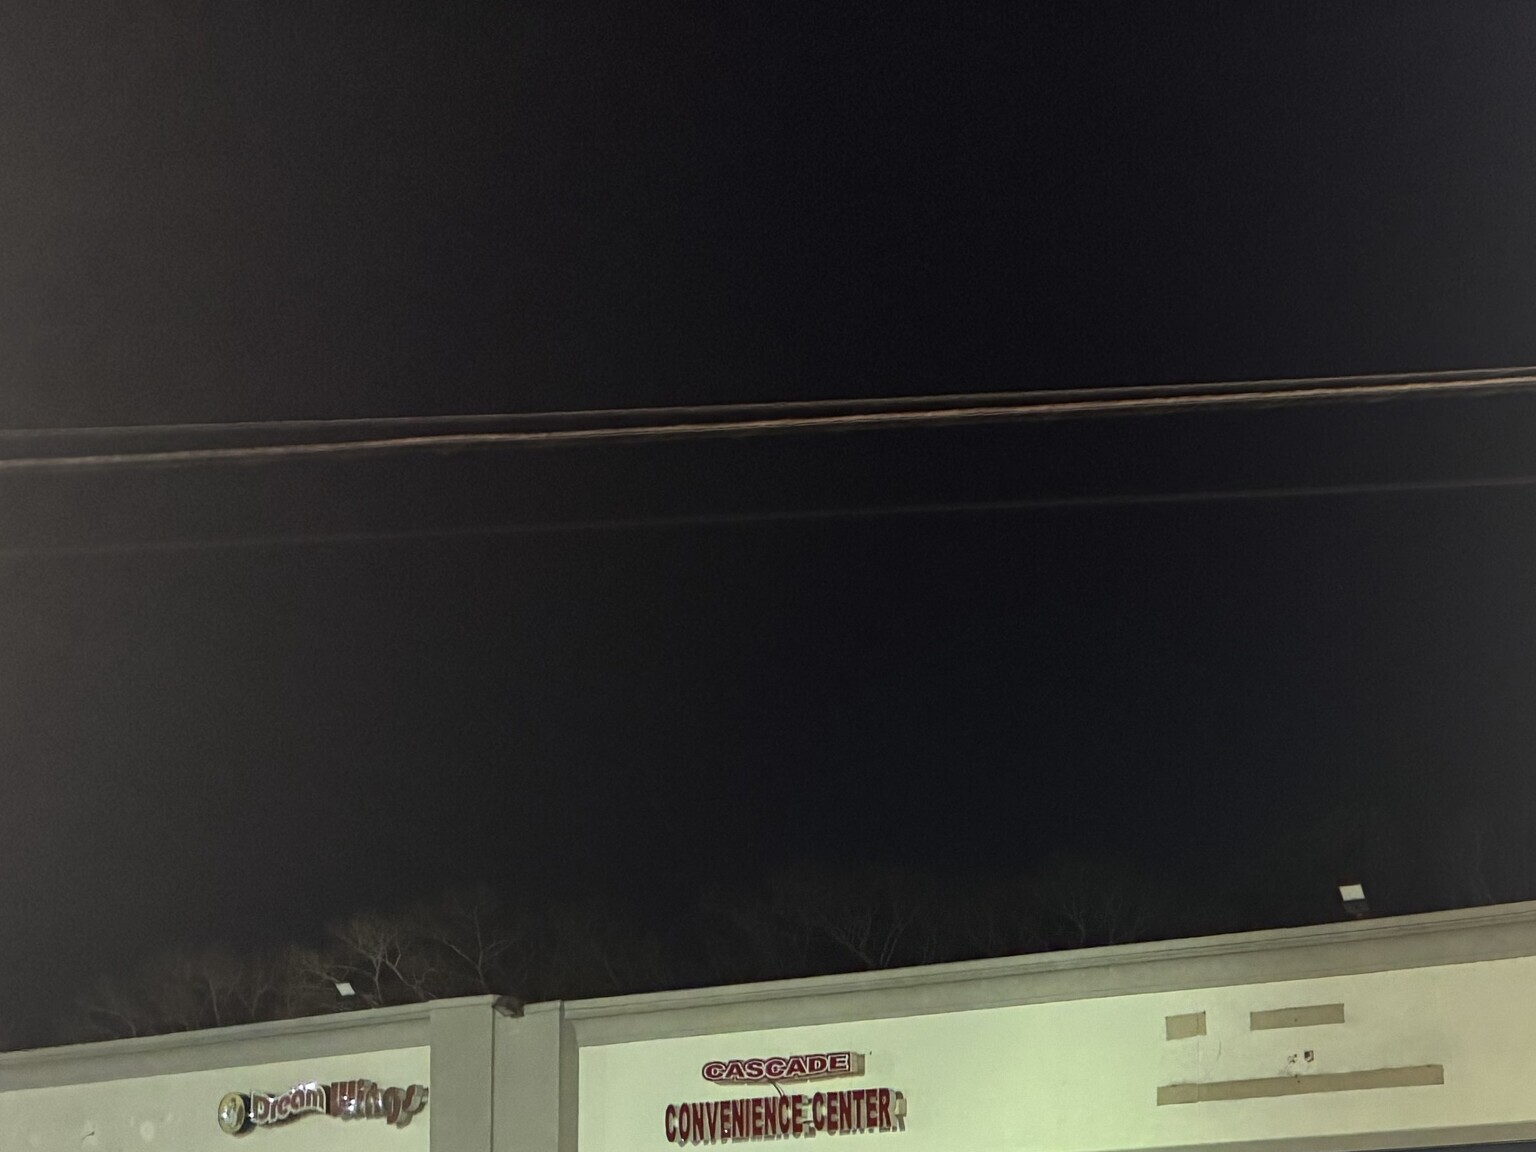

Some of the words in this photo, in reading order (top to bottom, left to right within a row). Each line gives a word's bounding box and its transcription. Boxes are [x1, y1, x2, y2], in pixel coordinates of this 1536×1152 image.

[702, 1052, 851, 1081] CASCADE
[250, 1082, 326, 1124] Dream
[330, 1079, 424, 1129] Wings
[665, 1095, 803, 1143] CONVENIENCE
[812, 1087, 893, 1132] CENTER
